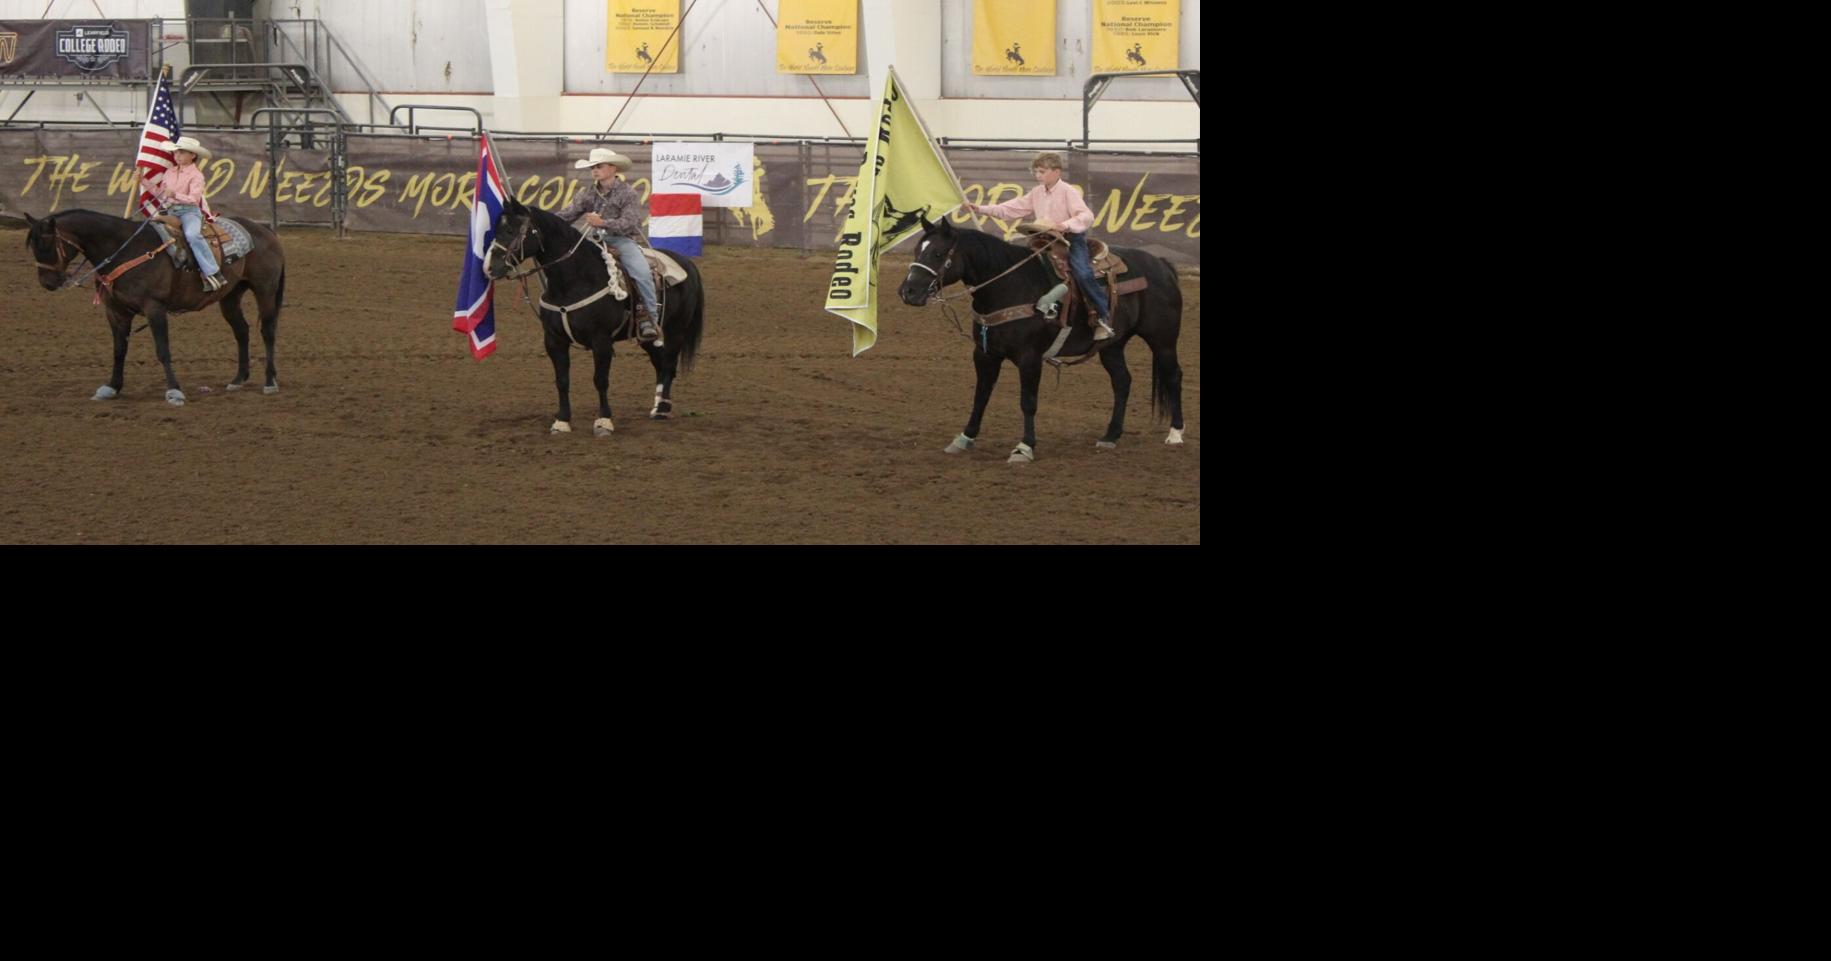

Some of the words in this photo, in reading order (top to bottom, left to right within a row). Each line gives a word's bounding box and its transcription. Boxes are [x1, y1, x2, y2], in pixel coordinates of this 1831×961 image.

[59, 38, 97, 53] COLLEGE
[97, 38, 126, 54] RODEO
[656, 154, 690, 162] LARAMIE
[693, 154, 716, 162] RIVER
[658, 162, 708, 184] Dental
[20, 153, 102, 212] THE
[398, 171, 479, 220] MOR
